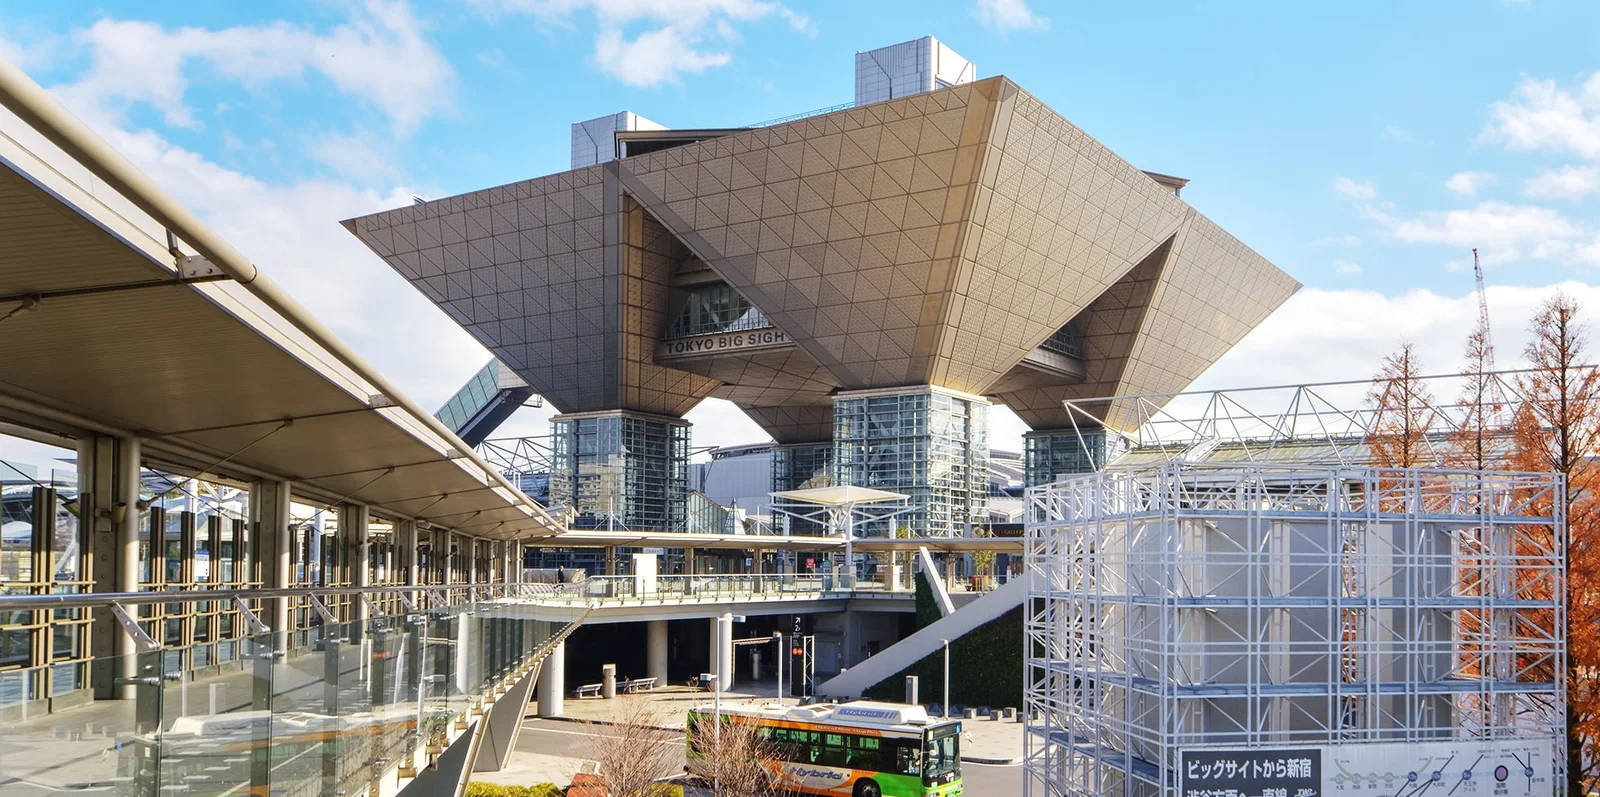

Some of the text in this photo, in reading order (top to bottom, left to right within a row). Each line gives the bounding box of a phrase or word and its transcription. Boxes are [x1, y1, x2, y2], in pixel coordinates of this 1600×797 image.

[666, 338, 714, 354] TOKYO
[718, 335, 743, 349] BIG
[790, 766, 844, 780] Hybrid
[1187, 758, 1312, 779] ビッグサイトから新宿
